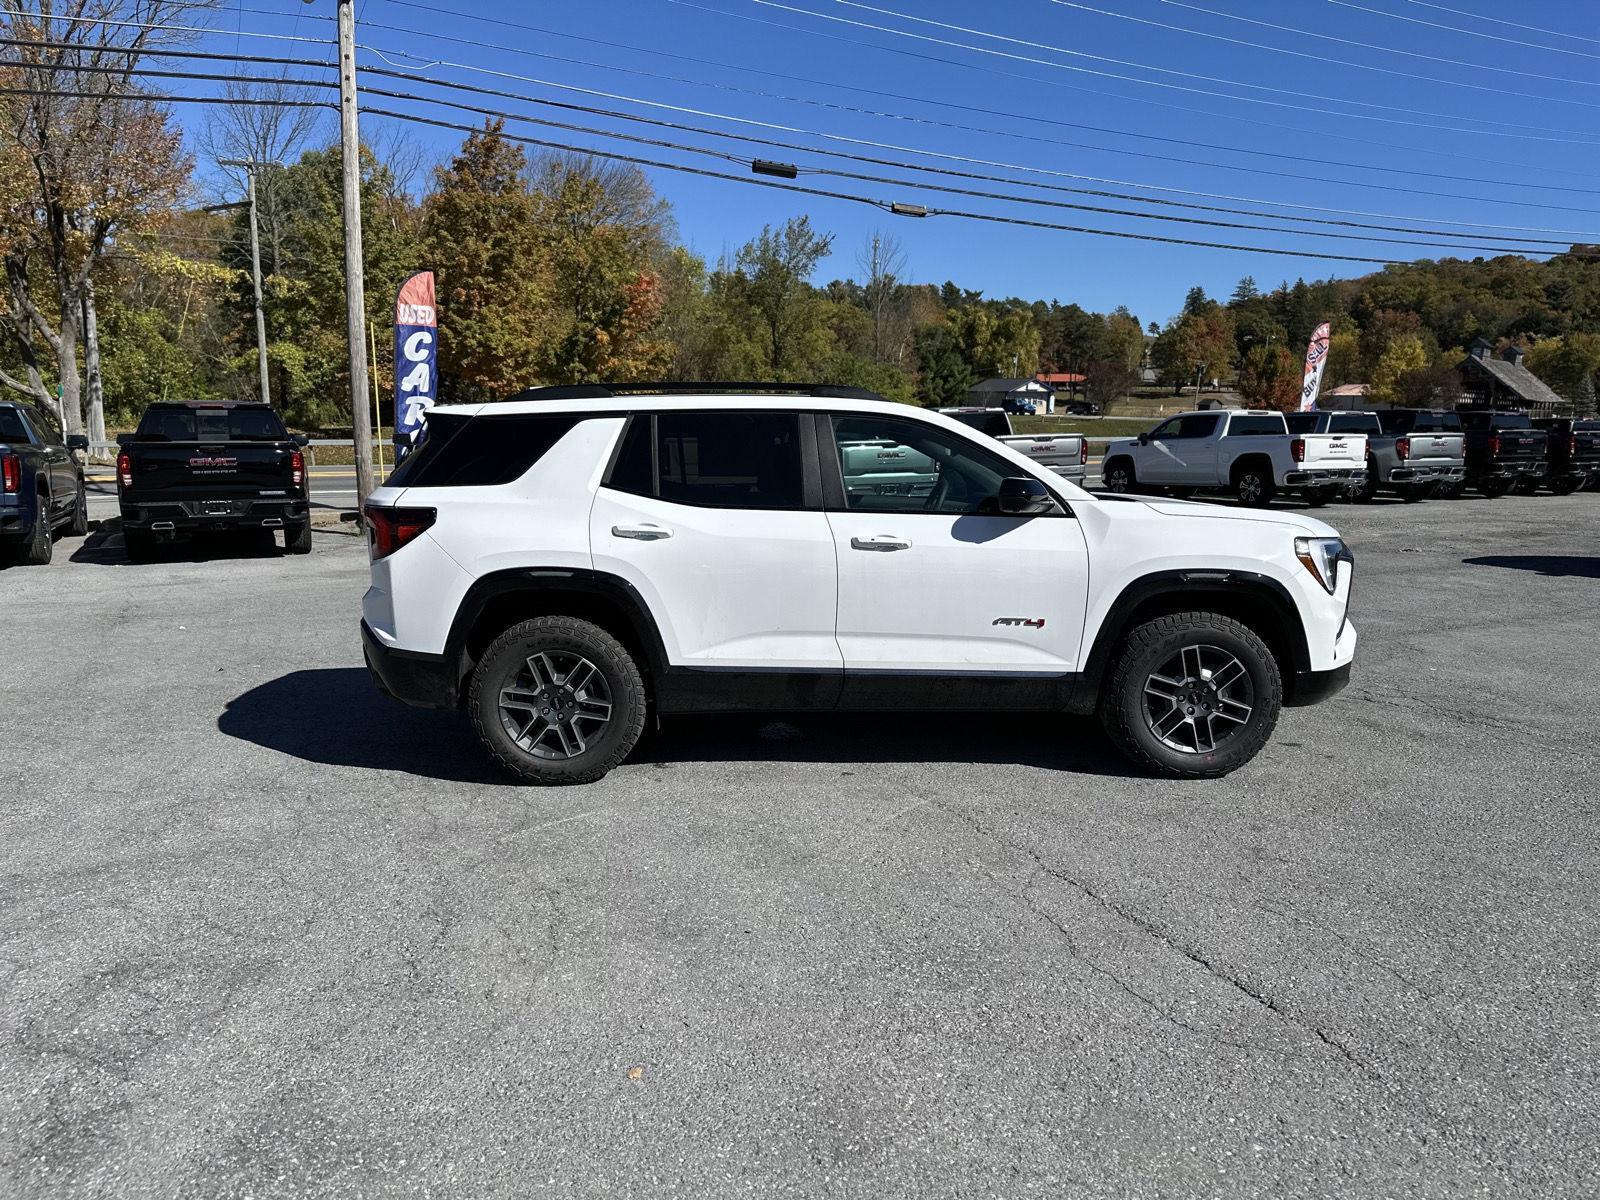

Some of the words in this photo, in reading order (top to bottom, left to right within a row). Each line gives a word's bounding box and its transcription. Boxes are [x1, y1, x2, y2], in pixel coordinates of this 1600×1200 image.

[400, 303, 434, 325] USED
[1308, 342, 1328, 364] SELL
[190, 457, 238, 467] GMC
[991, 617, 1045, 630] AT4
